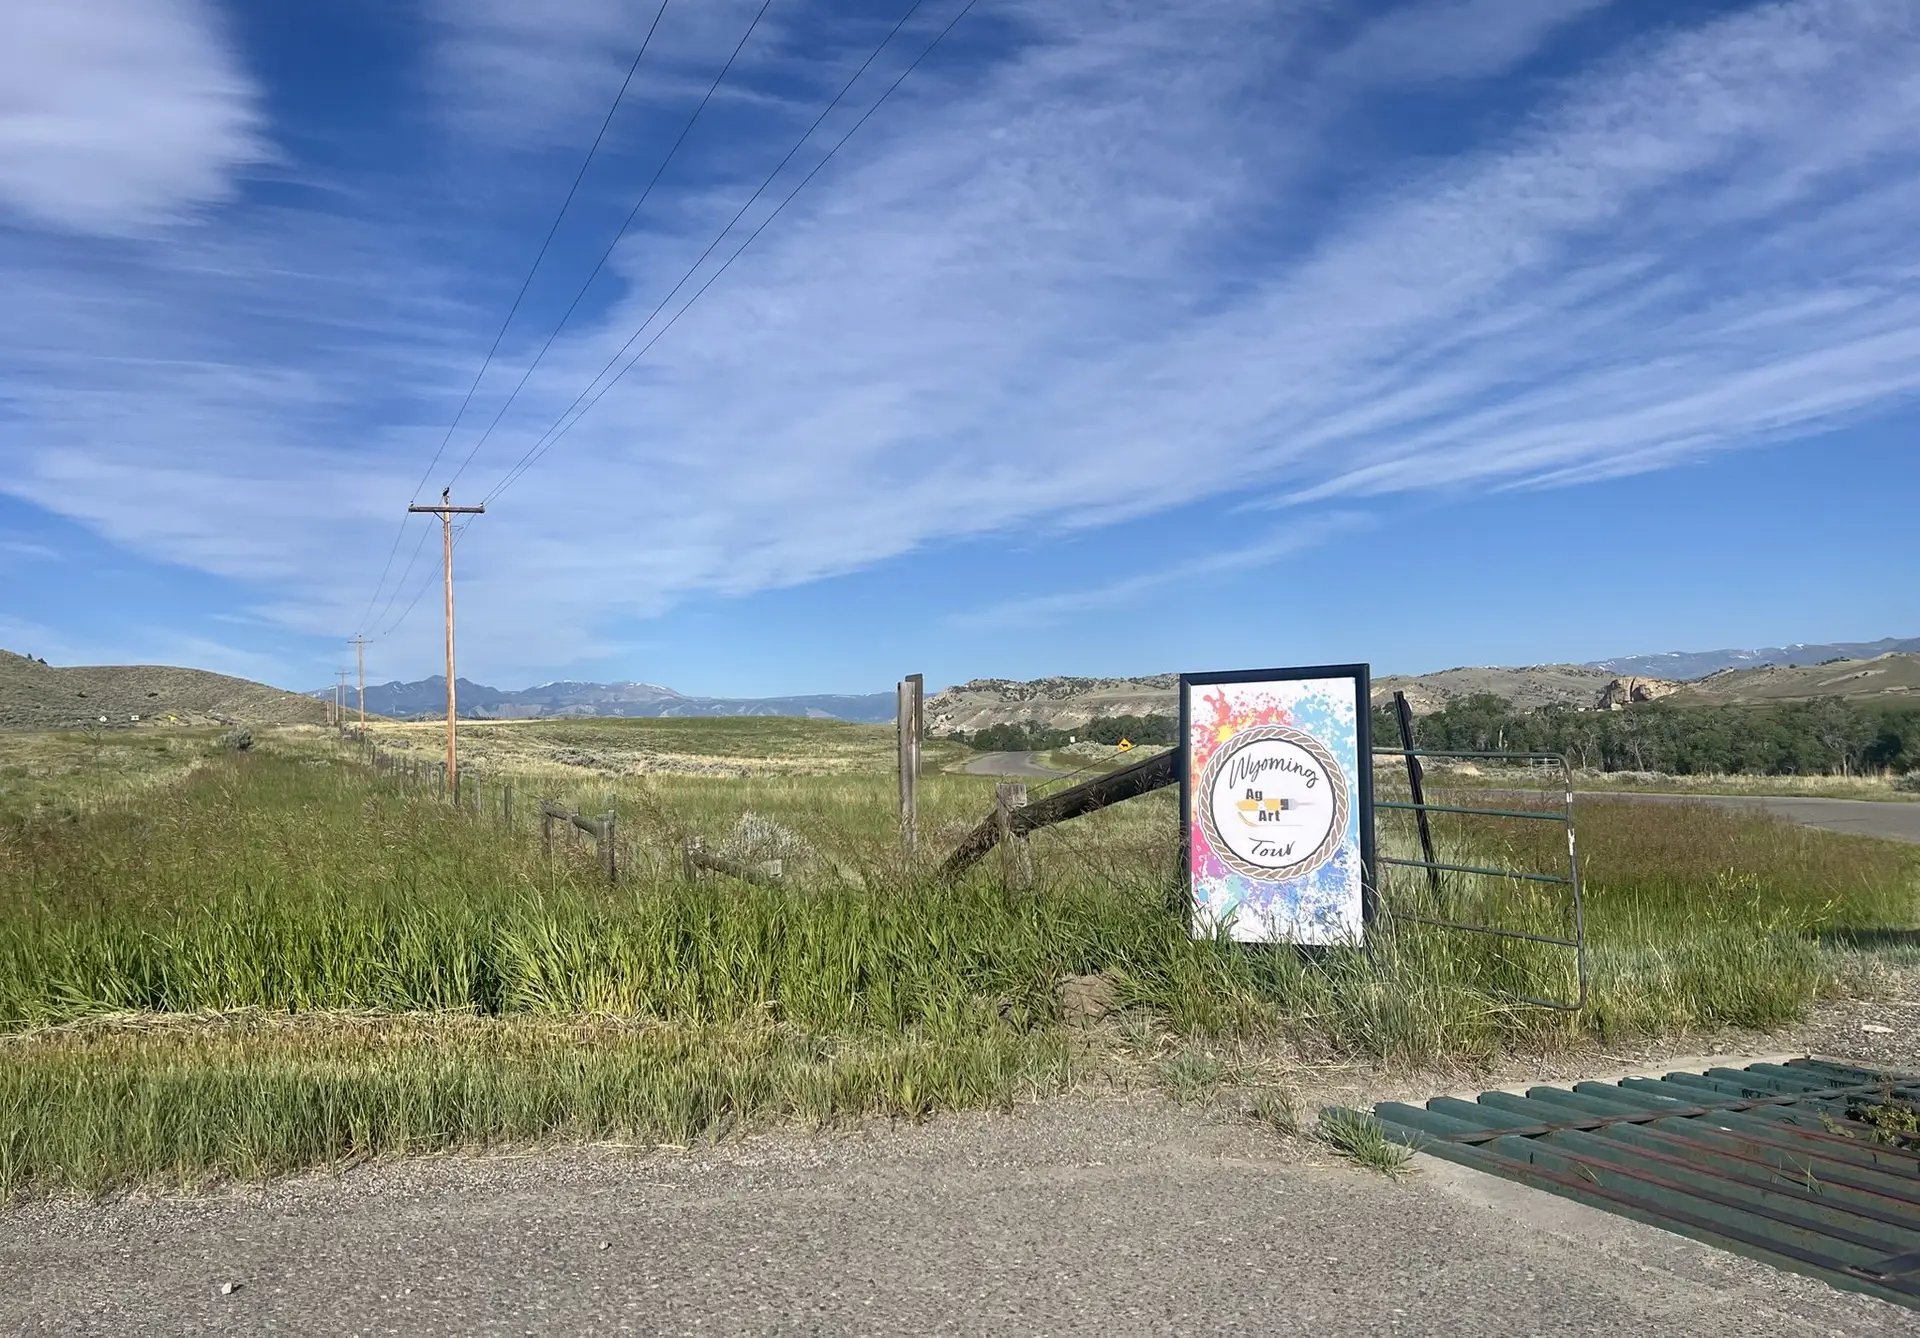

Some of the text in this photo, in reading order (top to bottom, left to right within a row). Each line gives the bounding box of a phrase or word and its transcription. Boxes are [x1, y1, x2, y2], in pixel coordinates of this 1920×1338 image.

[1229, 752, 1319, 789] Wyoming
[1245, 788, 1263, 801] Ag
[1258, 810, 1281, 822] Art
[1248, 837, 1295, 857] Tour
